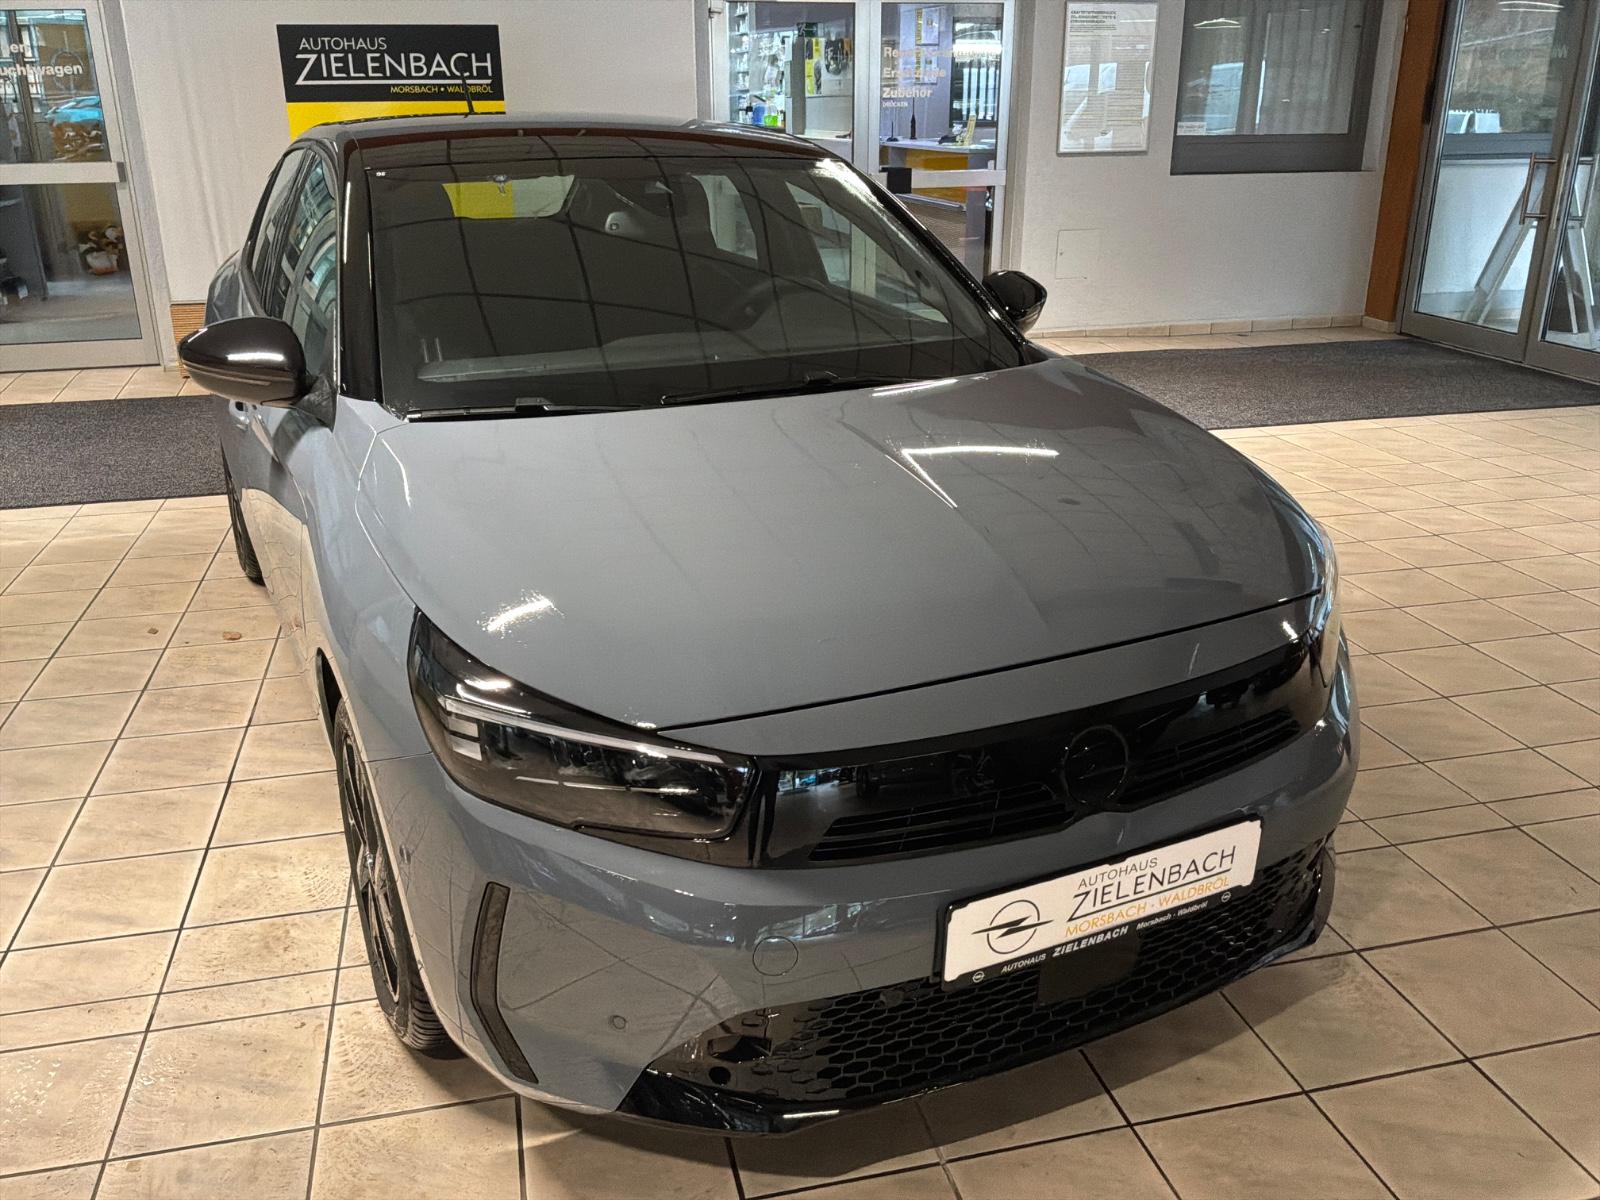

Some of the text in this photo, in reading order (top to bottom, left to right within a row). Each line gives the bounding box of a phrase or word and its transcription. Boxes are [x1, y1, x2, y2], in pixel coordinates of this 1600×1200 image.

[299, 37, 388, 51] AUTOHAUS
[294, 53, 493, 85] ZIELENBACH
[390, 86, 438, 94] MORSBACH
[1066, 845, 1237, 923] ZIELENBACH
[1077, 857, 1158, 890] AUTOHAUS
[1064, 876, 1230, 938] MORSBACH WALDBRÖL
[1001, 953, 1047, 975] AUTOHAUS
[1052, 925, 1129, 957] ZIELENBACH
[1136, 913, 1172, 930] Morsbach
